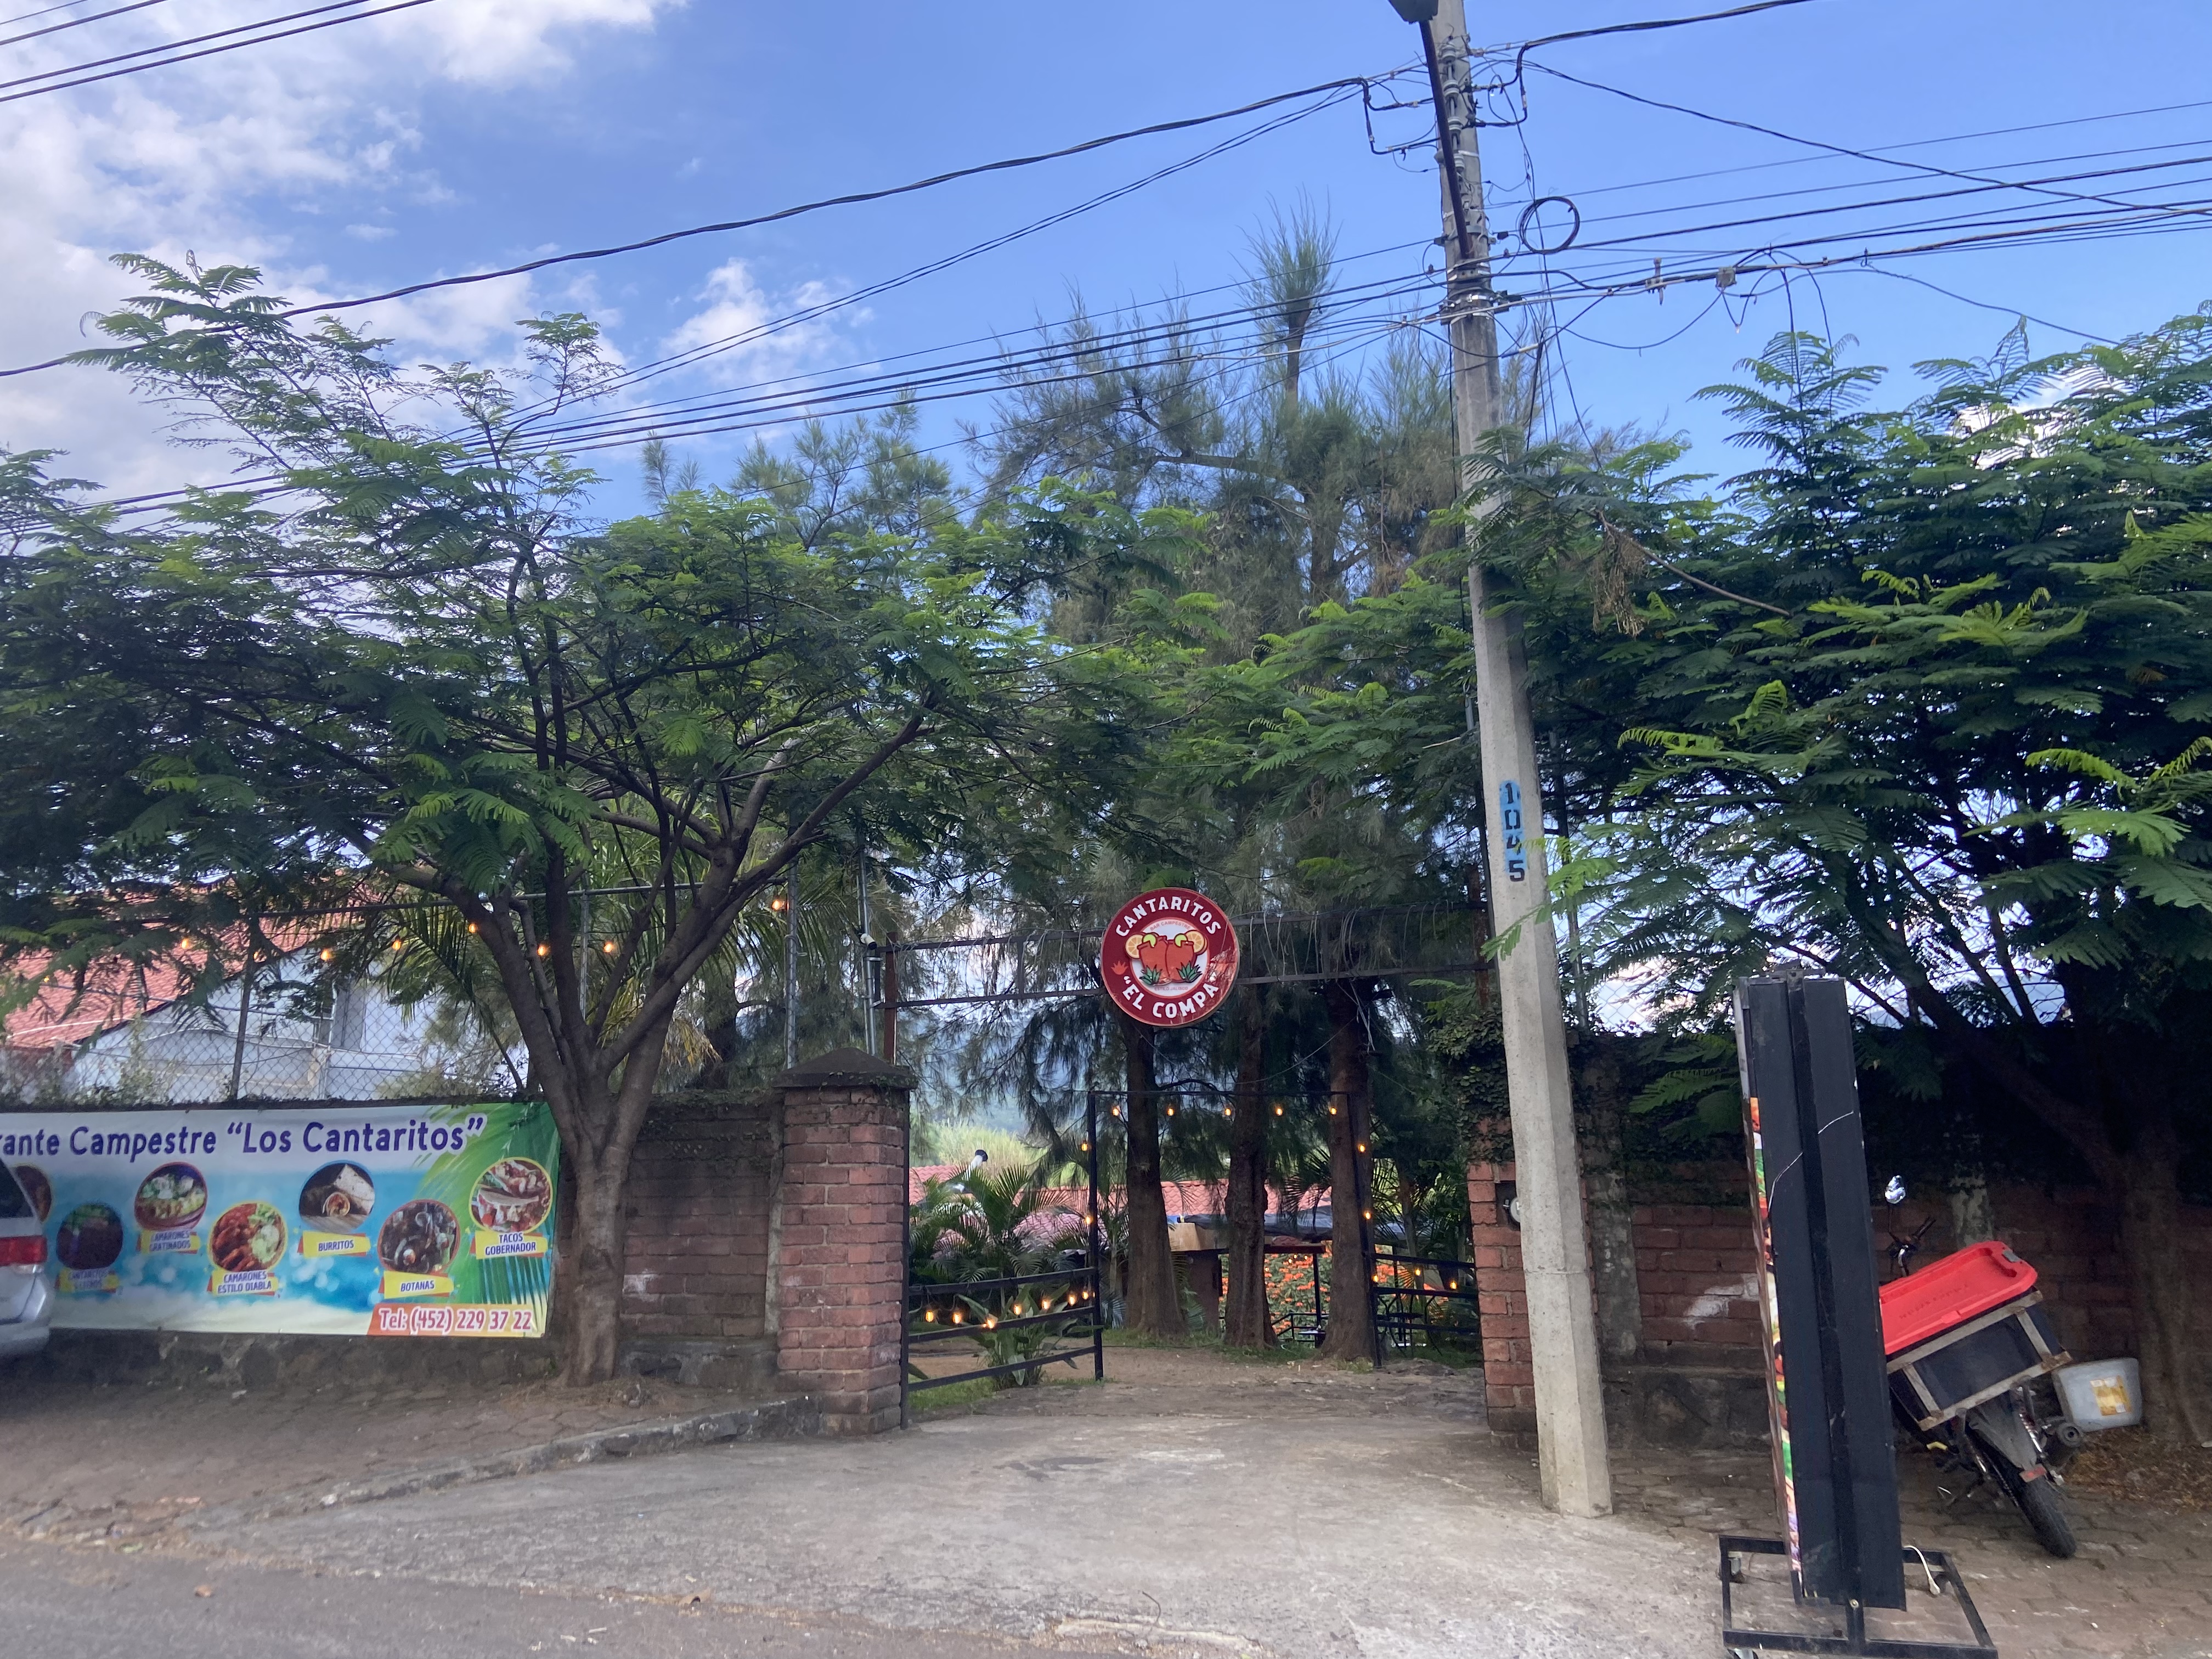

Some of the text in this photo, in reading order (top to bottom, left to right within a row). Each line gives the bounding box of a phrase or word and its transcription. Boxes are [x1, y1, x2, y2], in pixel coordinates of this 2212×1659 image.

[1116, 896, 1221, 936] CANTARITOS
[1161, 921, 1190, 930] CAMPESTRE
[0, 1128, 59, 1156] ante
[70, 1126, 216, 1163] Campestre
[499, 1232, 523, 1243] TACOS
[318, 1240, 354, 1251] BURRITOS
[485, 1242, 536, 1255] GOBERNADOR
[224, 1271, 267, 1283] CAMARONES
[218, 1280, 272, 1293] ESTILO DIABLA
[400, 1280, 435, 1292] BOTANAS
[380, 1308, 532, 1332] Tel: (452) 229 37 22
